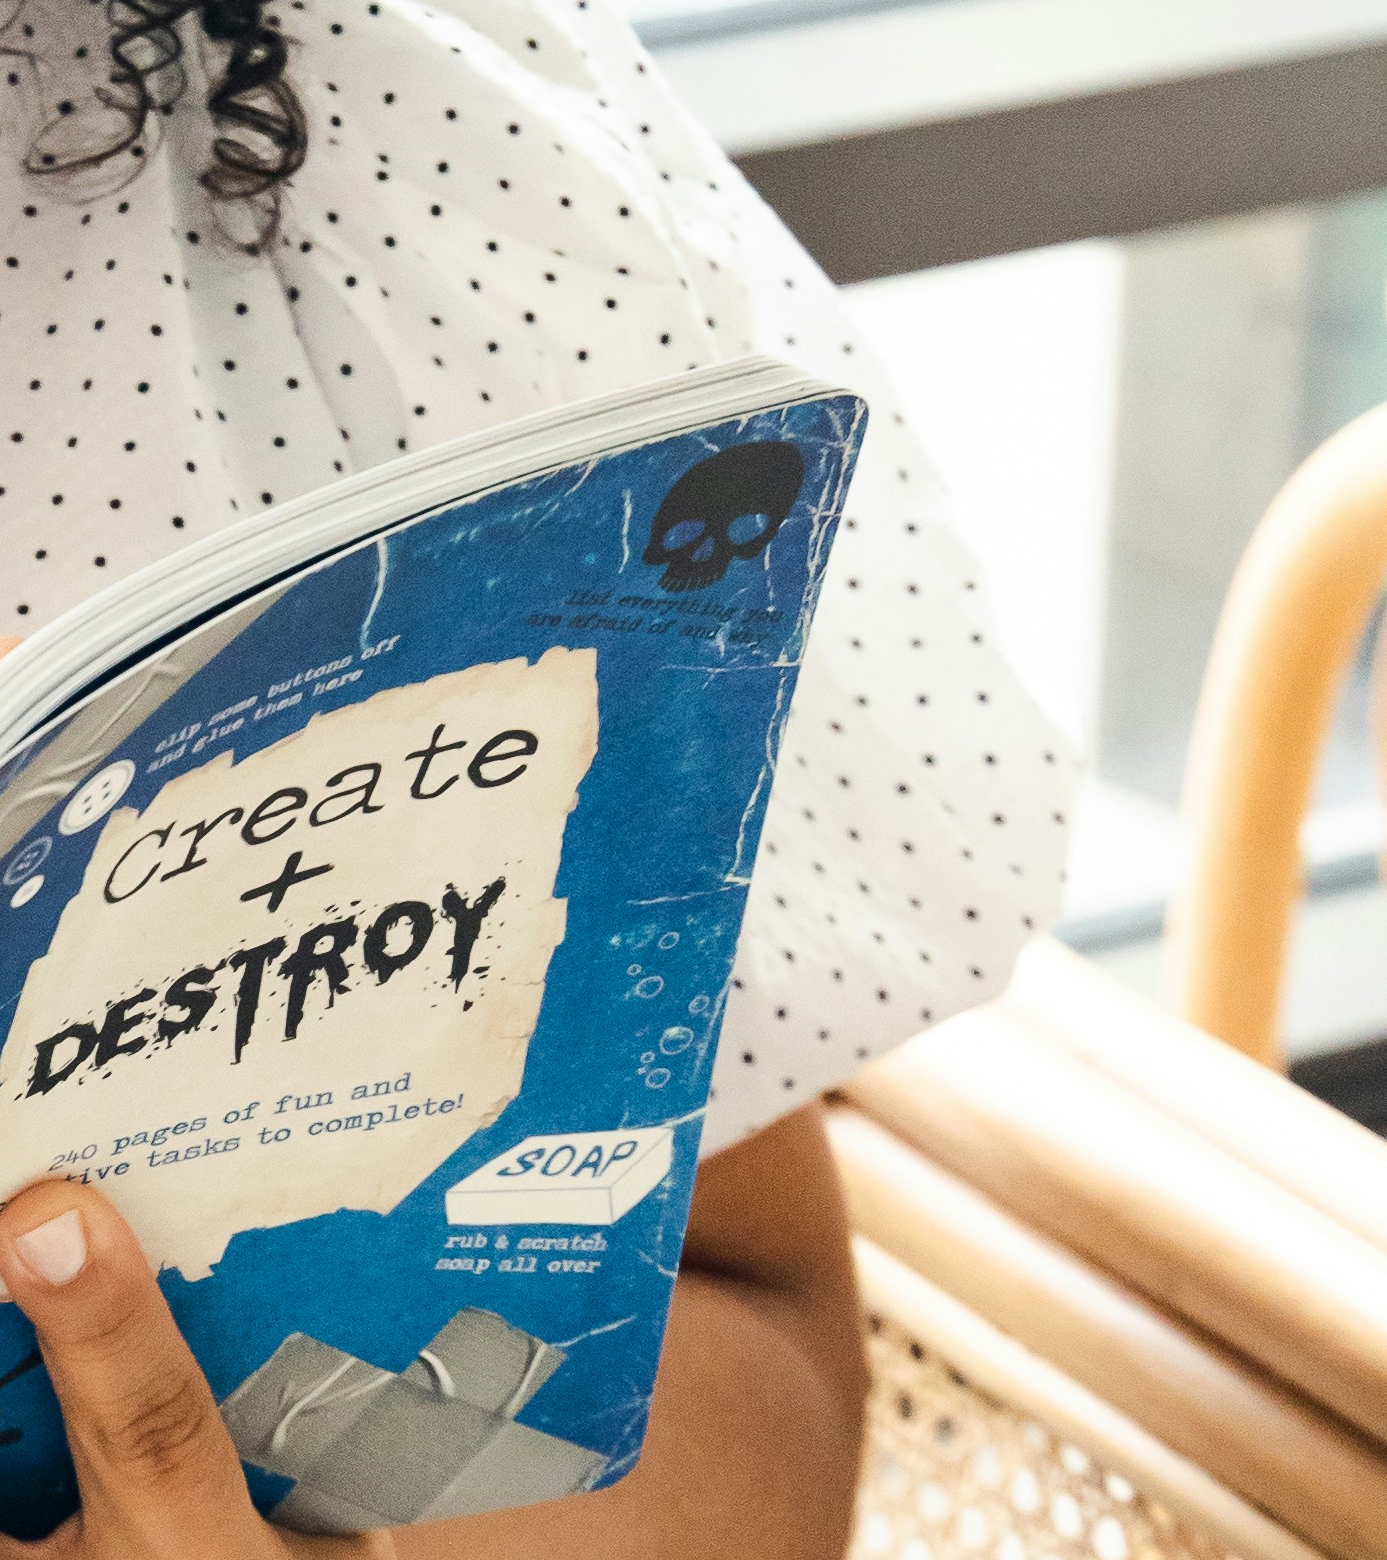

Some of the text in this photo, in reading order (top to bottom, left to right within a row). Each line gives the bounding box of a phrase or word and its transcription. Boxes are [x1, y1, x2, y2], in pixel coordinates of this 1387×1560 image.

[567, 611, 644, 633] afraid
[648, 618, 677, 636] of
[617, 595, 738, 621] everything
[146, 669, 363, 774] and glue them here
[155, 635, 401, 753] clip some buttons off
[103, 723, 538, 904] Create
[240, 851, 335, 913] +
[18, 875, 507, 1099] DESTROY
[47, 1072, 413, 1173] 240 pages of fun and
[146, 1136, 242, 1170] tasks
[258, 1124, 293, 1147] to
[307, 1092, 466, 1137] complete!
[496, 1140, 639, 1178] SOAP
[435, 1256, 602, 1275] soap all over
[444, 1232, 608, 1252] rub & scratch
